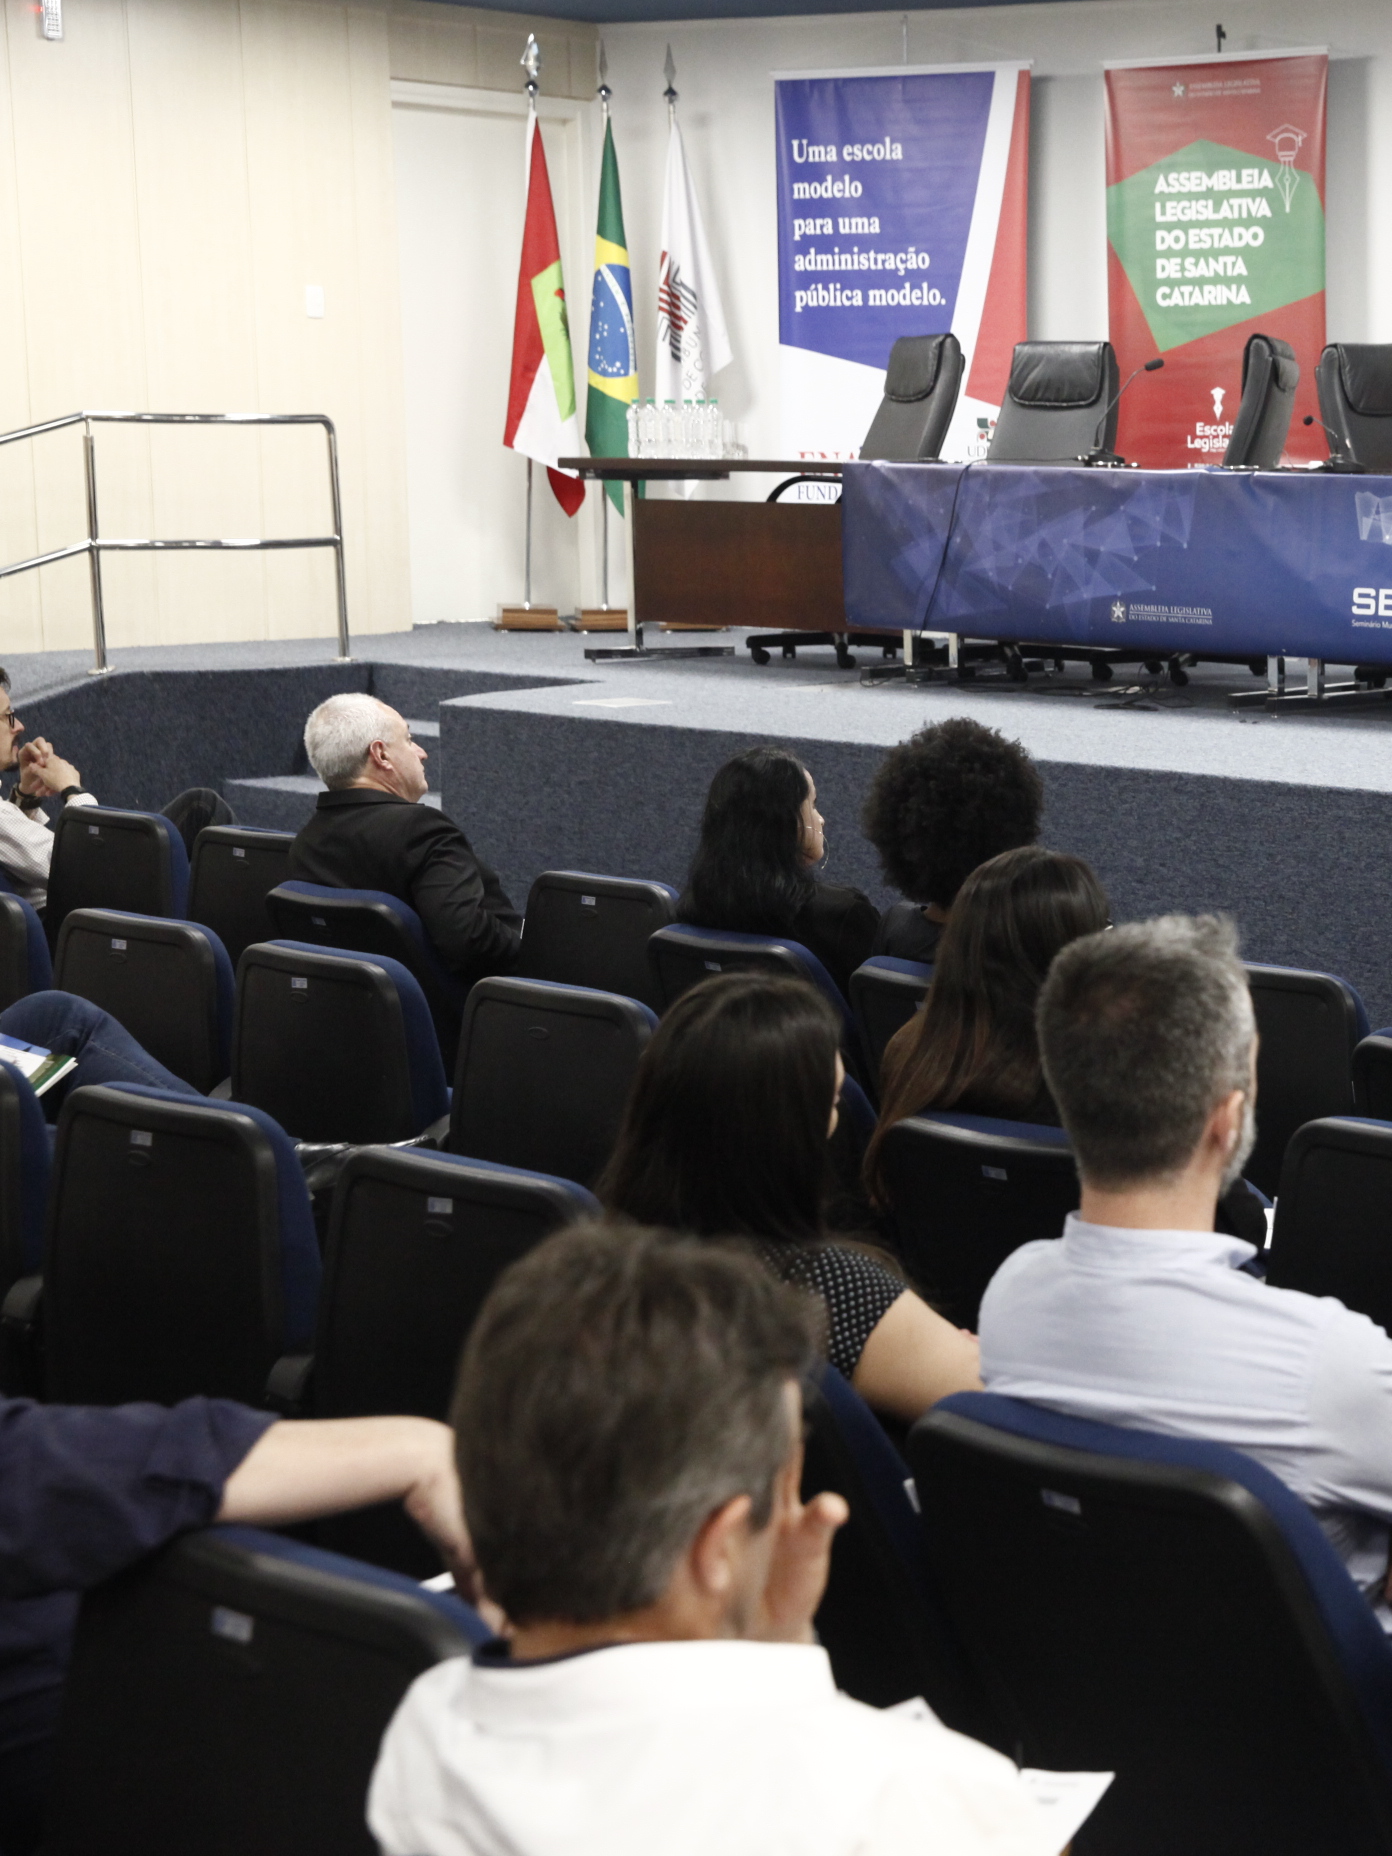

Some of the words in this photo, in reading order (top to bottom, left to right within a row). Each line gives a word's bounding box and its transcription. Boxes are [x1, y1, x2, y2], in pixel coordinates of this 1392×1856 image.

[791, 139, 837, 163] Uma
[843, 137, 903, 161] escola
[793, 175, 862, 199] modelo
[1154, 168, 1274, 194] ASSEMBLEIA
[1155, 197, 1272, 222] LEGISLATIVA
[793, 217, 833, 240] para
[838, 217, 880, 234] uma
[1156, 229, 1186, 251] DO
[1188, 226, 1265, 250] ESTADO
[794, 247, 930, 275] administração
[1156, 257, 1181, 279] DE
[1184, 256, 1248, 278] SANTA
[795, 283, 863, 312] pública
[868, 282, 946, 305] modelo.
[1156, 284, 1251, 307] CATARINA
[1129, 604, 1169, 613] ASSEMBLEIA
[1170, 606, 1212, 616] LEGISLATIVA
[1351, 619, 1381, 628] Seminário
